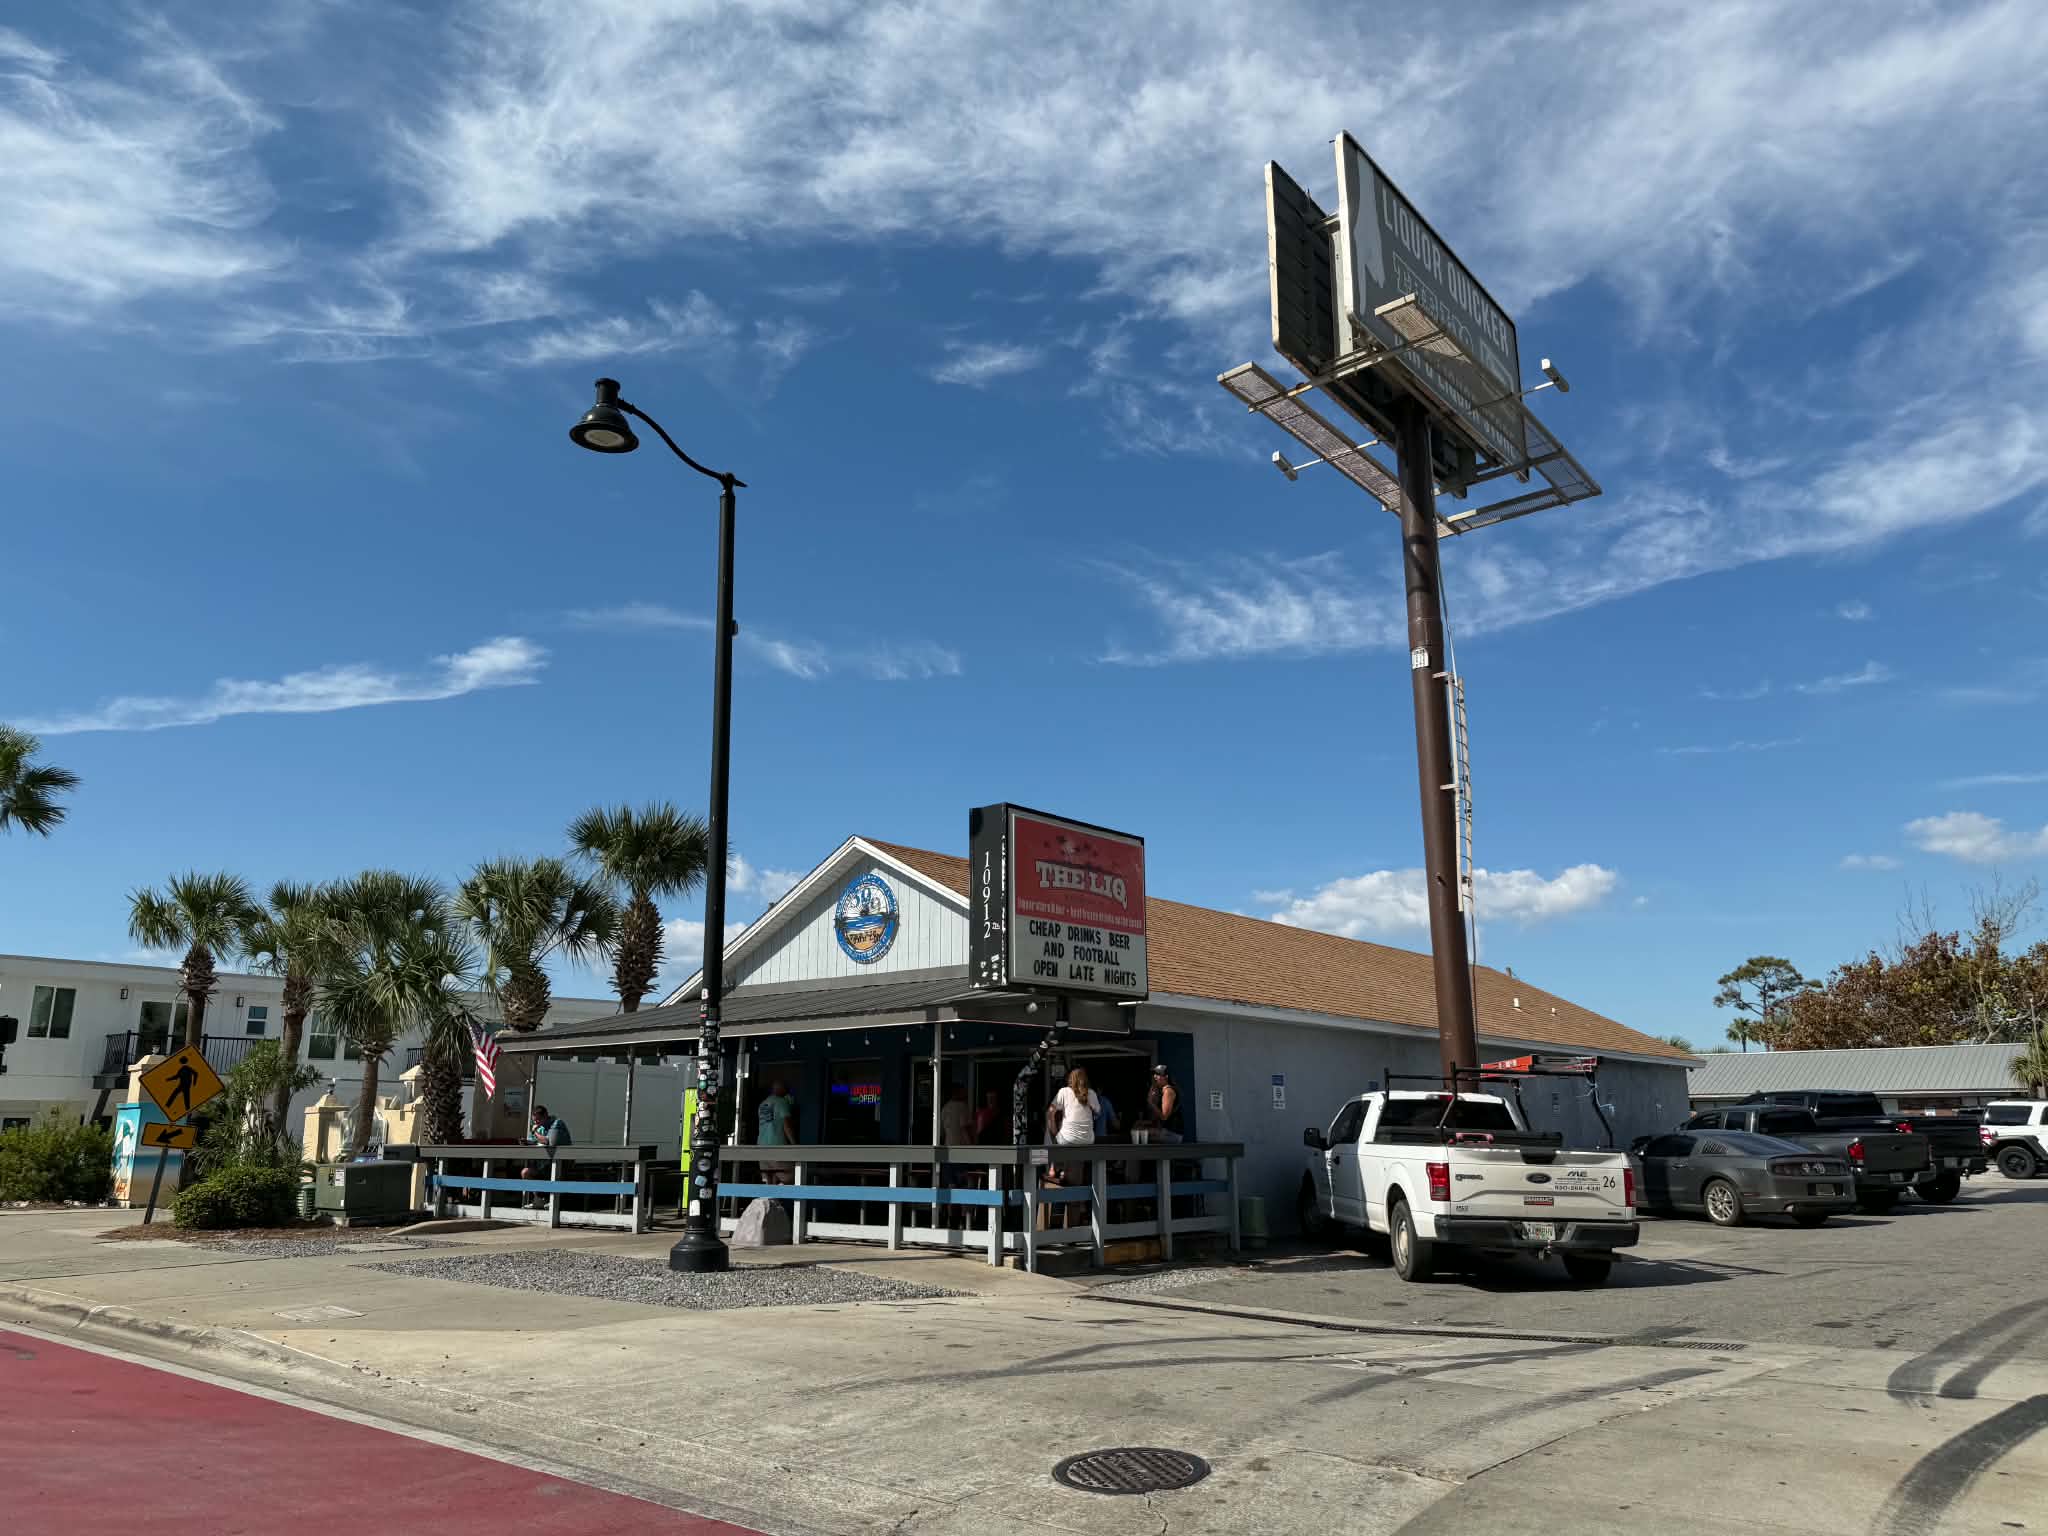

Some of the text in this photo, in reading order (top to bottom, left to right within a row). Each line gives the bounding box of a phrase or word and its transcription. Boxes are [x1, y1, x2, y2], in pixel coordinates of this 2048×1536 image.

[1382, 184, 1509, 357] LIQUOR QUICKER
[983, 851, 991, 939] 10912
[1035, 859, 1128, 910] THE LIQ
[1029, 919, 1130, 950] CHEAP DRINKS BEER
[1043, 941, 1120, 966] AND FOOTBALL
[1033, 959, 1137, 986] OPEN LATE NIGHTS
[858, 1094, 877, 1104] OPEN
[1603, 1175, 1616, 1189] 26
